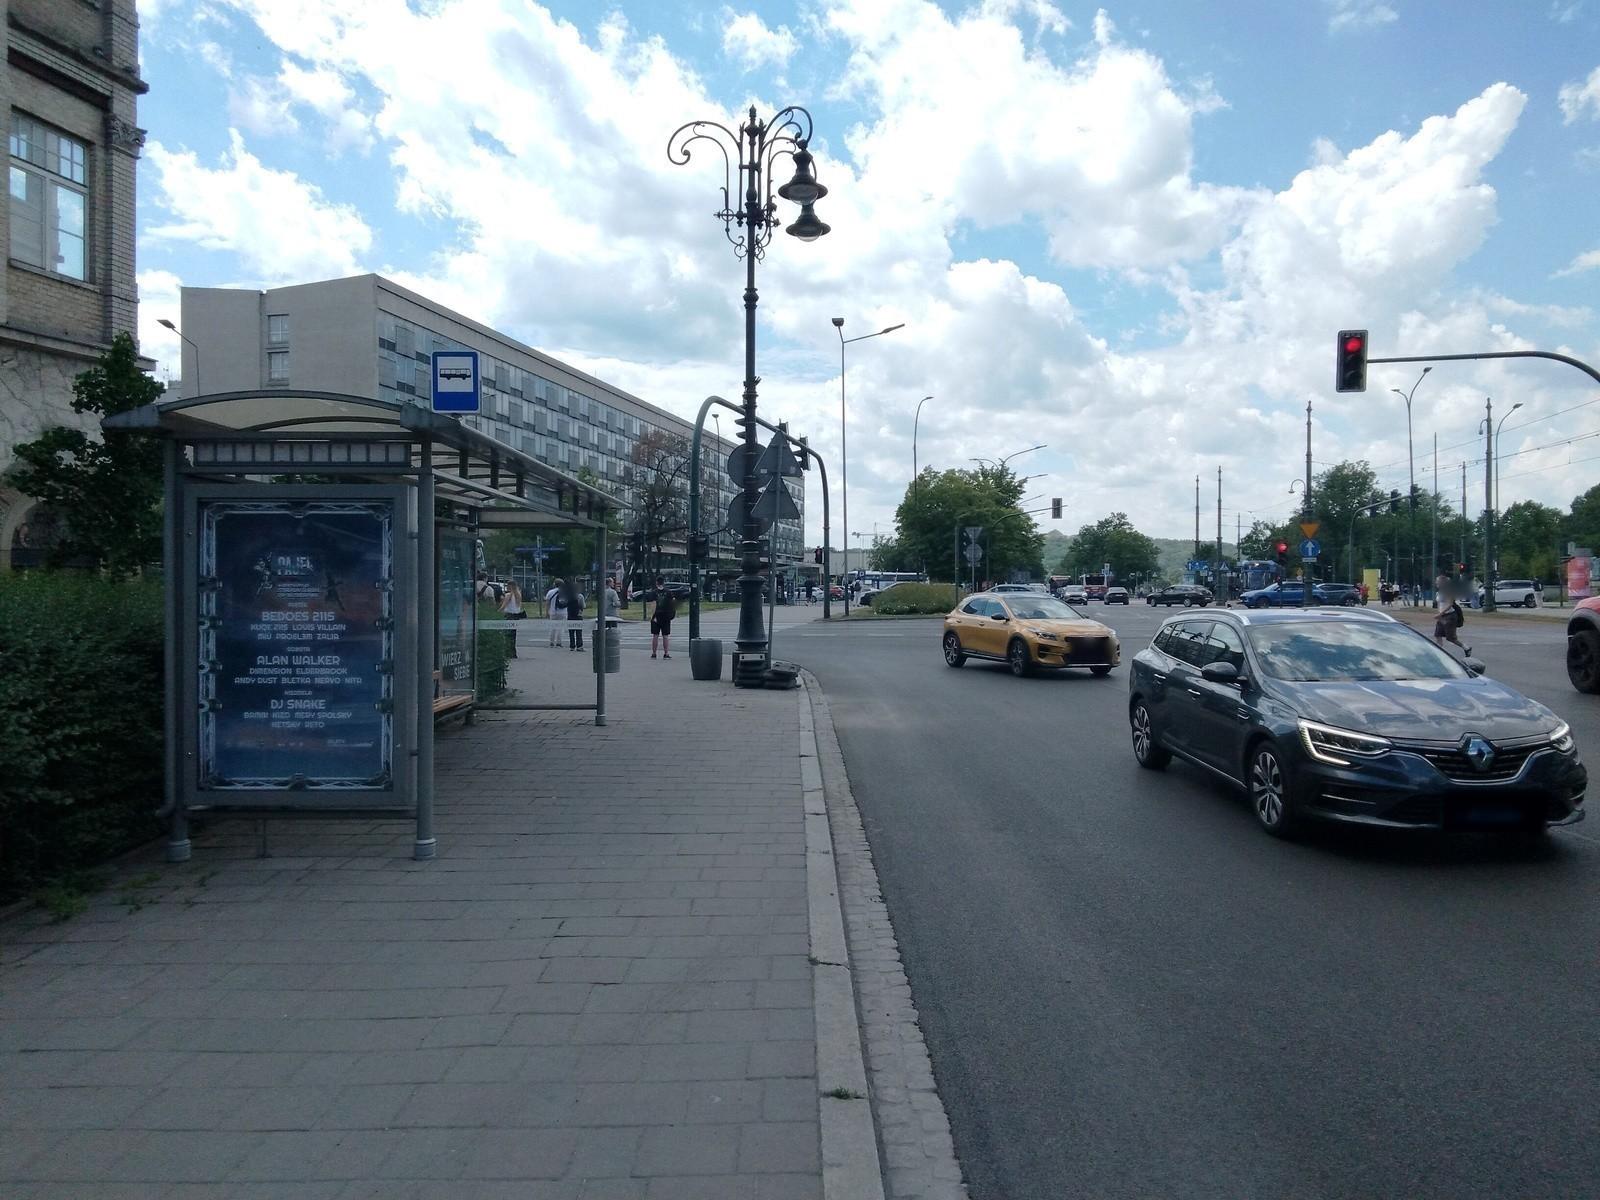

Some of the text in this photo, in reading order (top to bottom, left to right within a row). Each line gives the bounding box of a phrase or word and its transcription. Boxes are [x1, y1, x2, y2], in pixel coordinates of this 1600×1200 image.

[261, 611, 335, 621] BEDOES 2115
[257, 655, 340, 665] ALAN WALKER
[270, 699, 326, 709] DJ SNAKE
